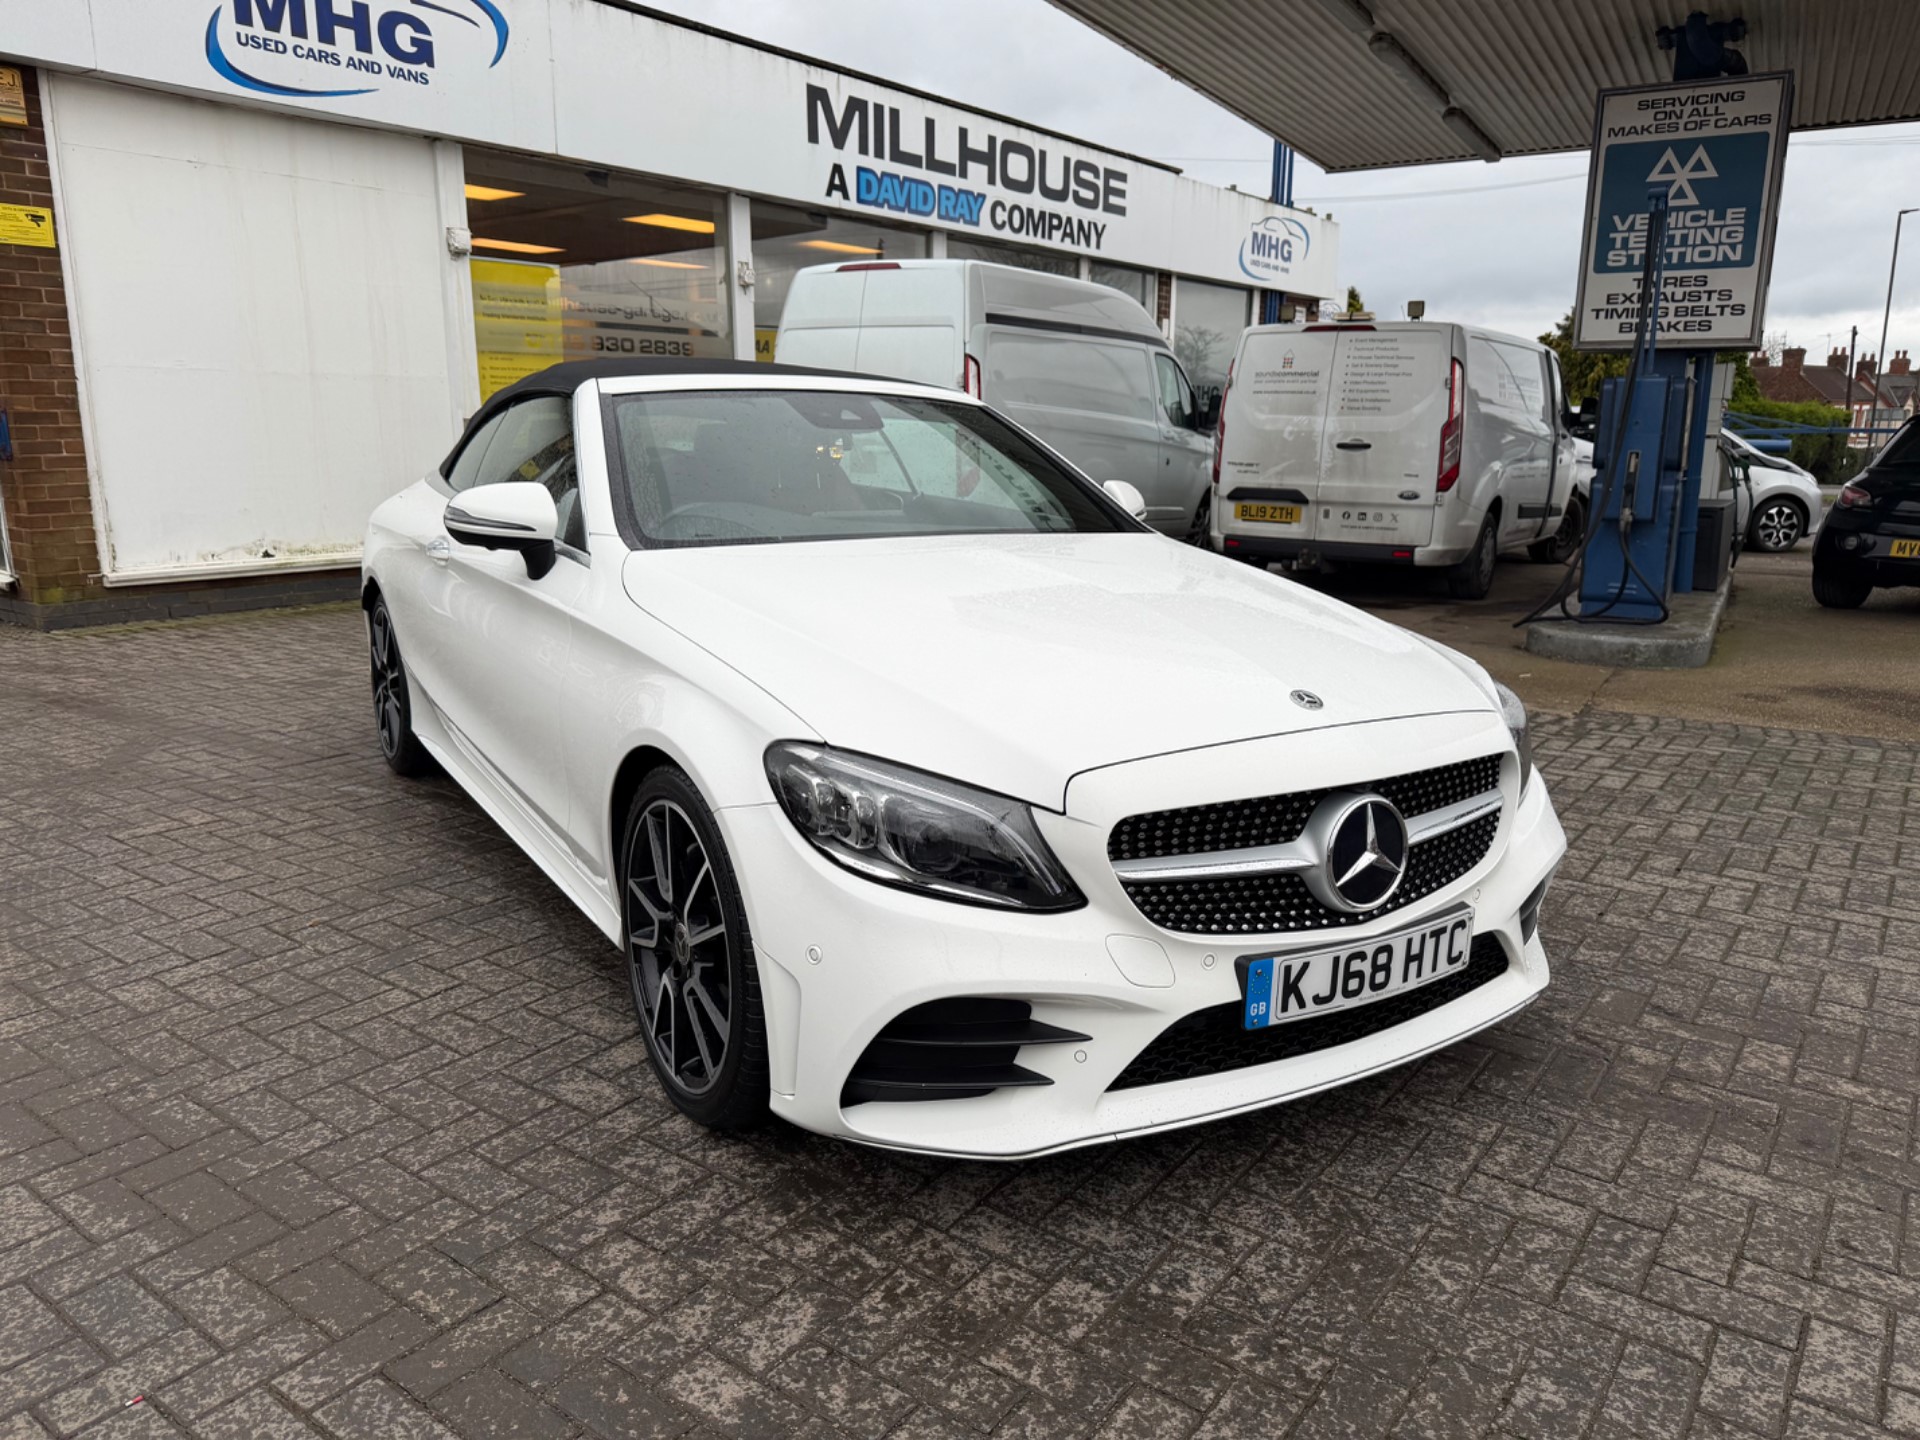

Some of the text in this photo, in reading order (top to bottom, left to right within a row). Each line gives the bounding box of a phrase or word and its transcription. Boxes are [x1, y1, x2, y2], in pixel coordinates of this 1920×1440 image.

[232, 0, 435, 69] MHG
[236, 31, 430, 85] USED CARS AND VANS
[1637, 90, 1746, 111] SERVICING
[1653, 105, 1725, 122] ON ALL
[1607, 113, 1772, 138] MAKES OF CARS
[806, 82, 1128, 217] MILLHOUSE
[825, 163, 1107, 250] A DAVID RAY COMPANY
[1251, 231, 1293, 263] MHG
[1609, 225, 1744, 249] TETING
[1607, 244, 1743, 267] STTION
[1633, 275, 1708, 289] TRES
[1674, 304, 1746, 318] BELTS
[591, 335, 634, 353] 930
[639, 338, 694, 357] 2839
[1241, 505, 1294, 520] BL19 ZTH
[1280, 919, 1468, 1014] KJ68 HTC
[1250, 1001, 1267, 1016] GB
